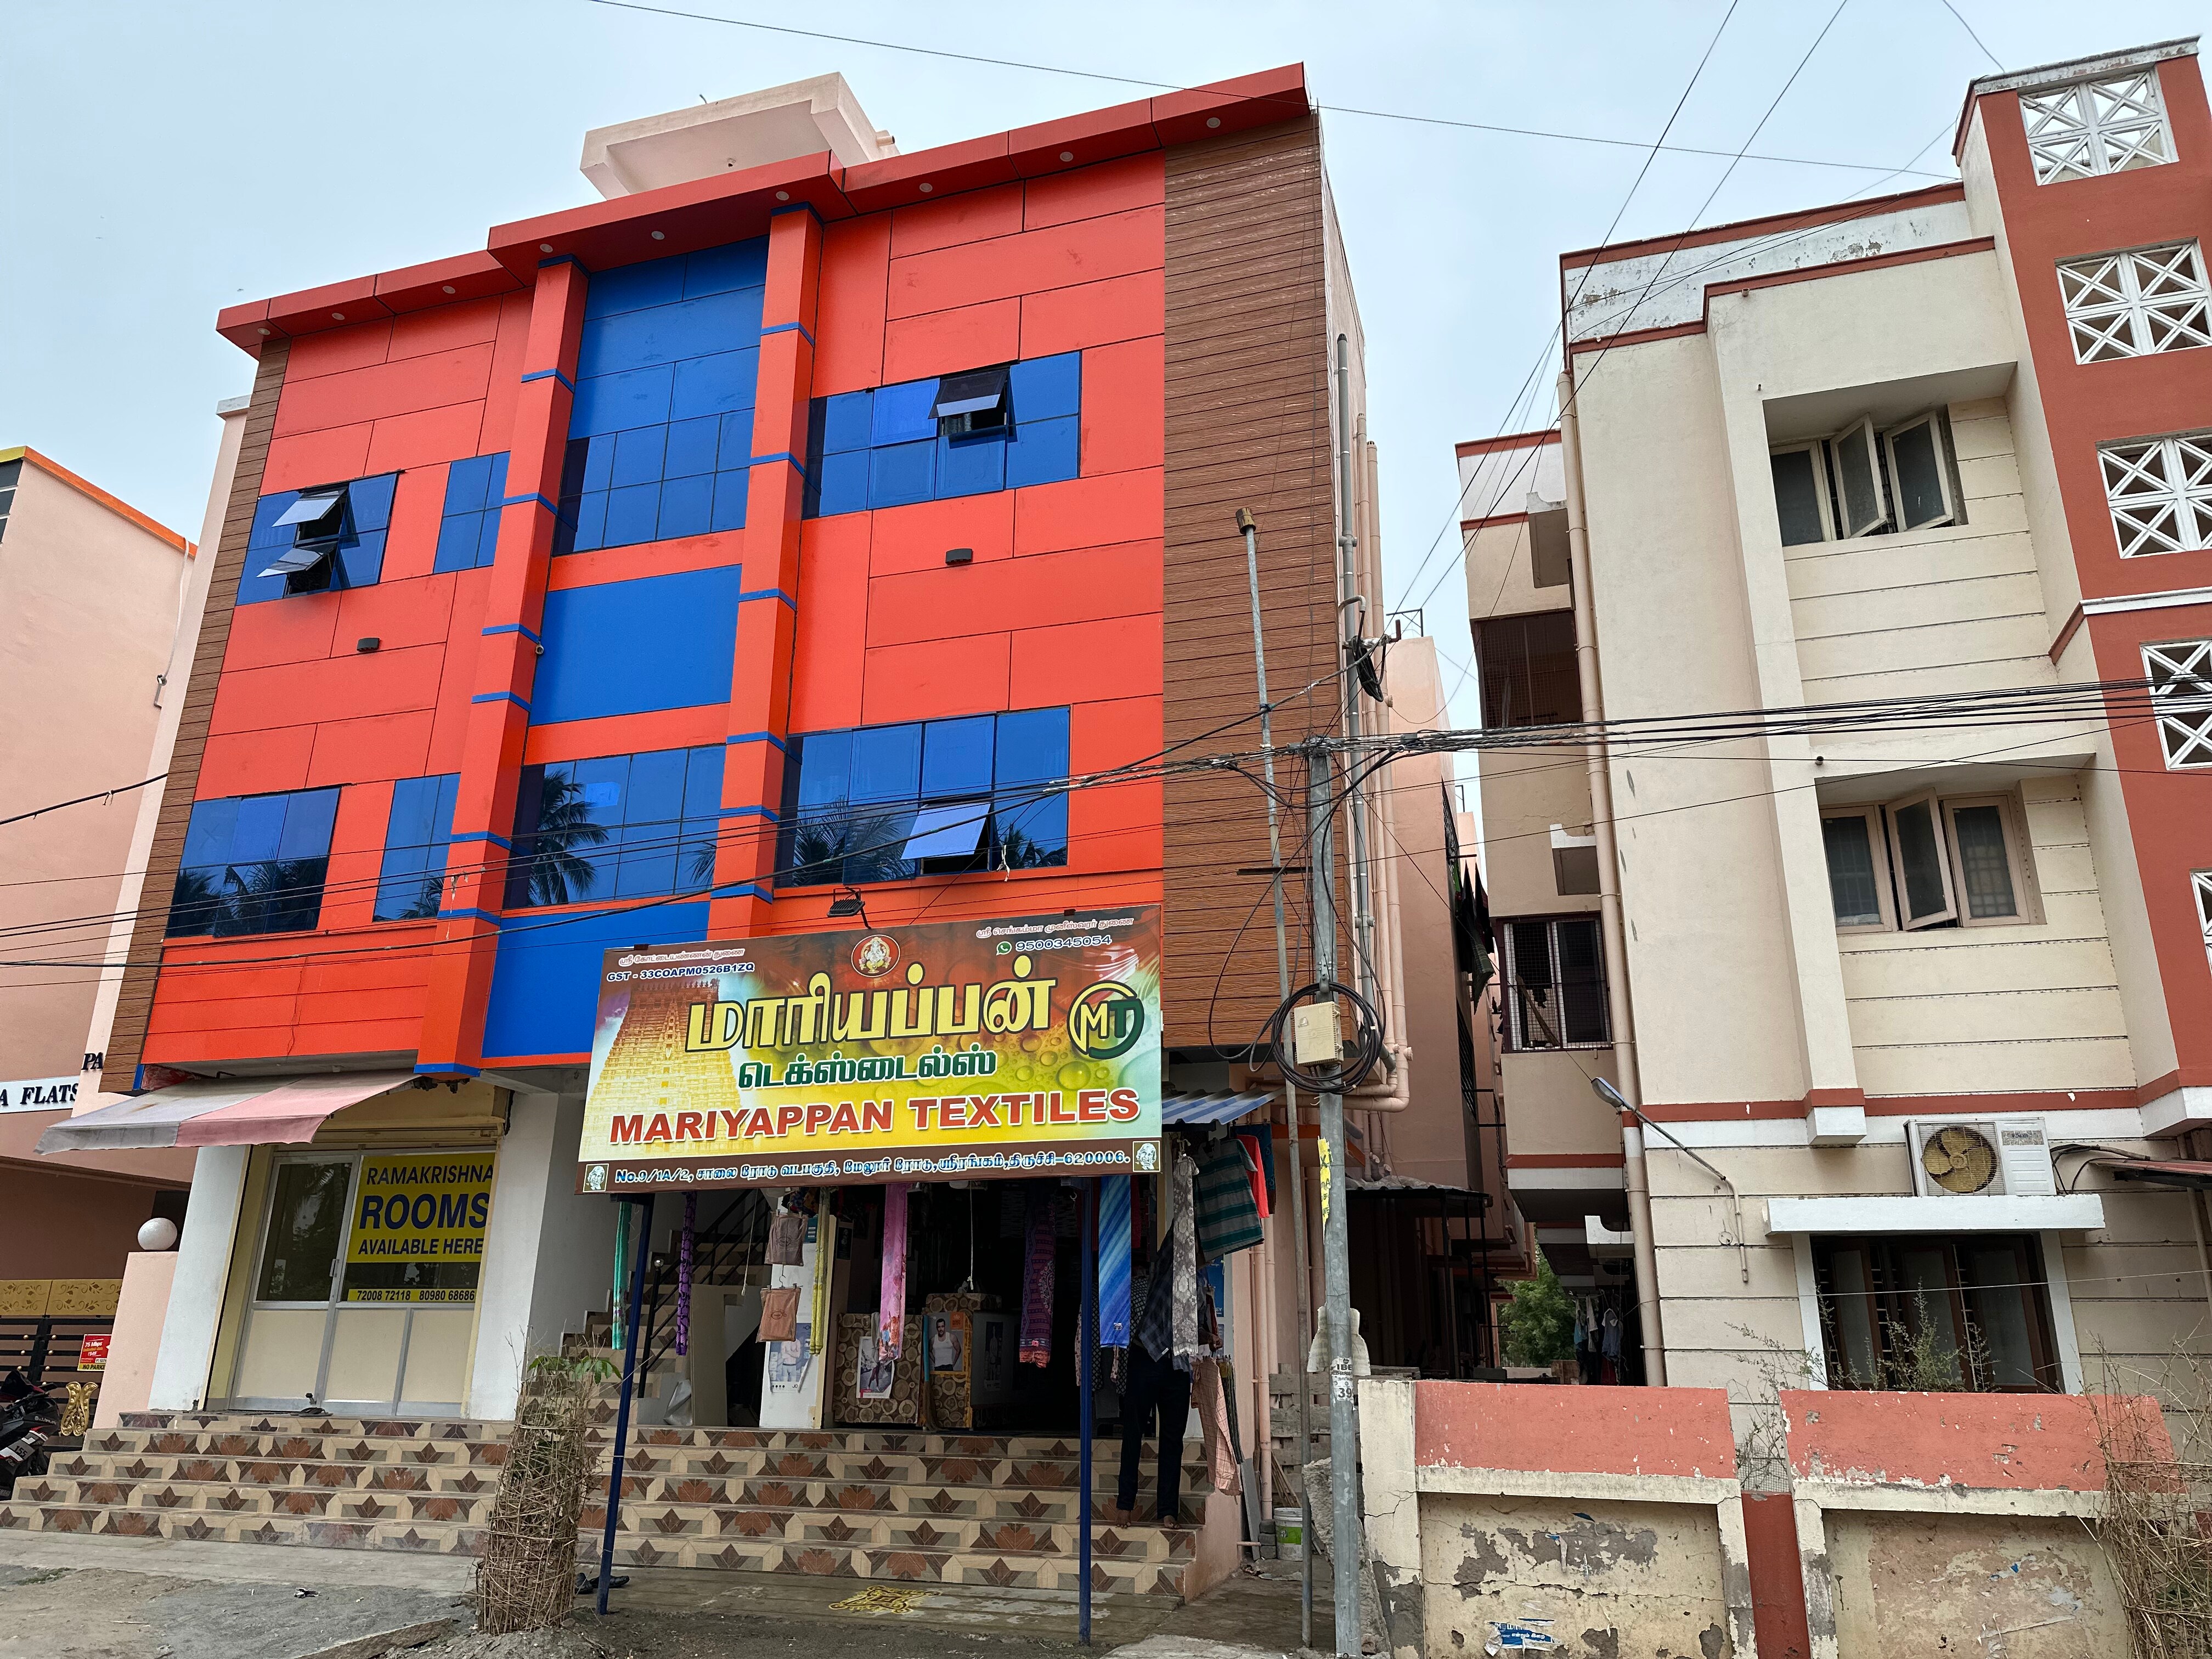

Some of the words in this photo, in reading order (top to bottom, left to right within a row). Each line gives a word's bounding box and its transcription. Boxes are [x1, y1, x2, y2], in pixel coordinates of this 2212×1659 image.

[1098, 918, 1134, 929] துணை
[1015, 935, 1111, 952] 9500345054
[713, 949, 745, 960] துணை
[607, 972, 631, 981] GST
[640, 962, 755, 980] 33COAPM0526B1ZQ
[685, 955, 1057, 1053] மாரியப்பன்
[738, 1042, 997, 1090] டெக்ஸ்டைல்ஸ்
[610, 1100, 893, 1146] MARIYAPPAN
[908, 1087, 1141, 1130] TEXTILES
[366, 1164, 493, 1185] RAMAKRISHNA
[696, 1167, 737, 1181] சாலை
[740, 1164, 778, 1181] ரோடு
[843, 1157, 891, 1176] மேலூர்
[359, 1193, 490, 1229] ROOMS
[358, 1238, 439, 1255] AVAILABLE
[442, 1238, 484, 1254] HERE
[357, 1290, 382, 1300] 72008
[385, 1290, 410, 1300] 72118
[419, 1290, 445, 1300] 80980
[448, 1290, 475, 1300] 68686
[1338, 1387, 1353, 1398] 39
[14, 1445, 27, 1458] 155
